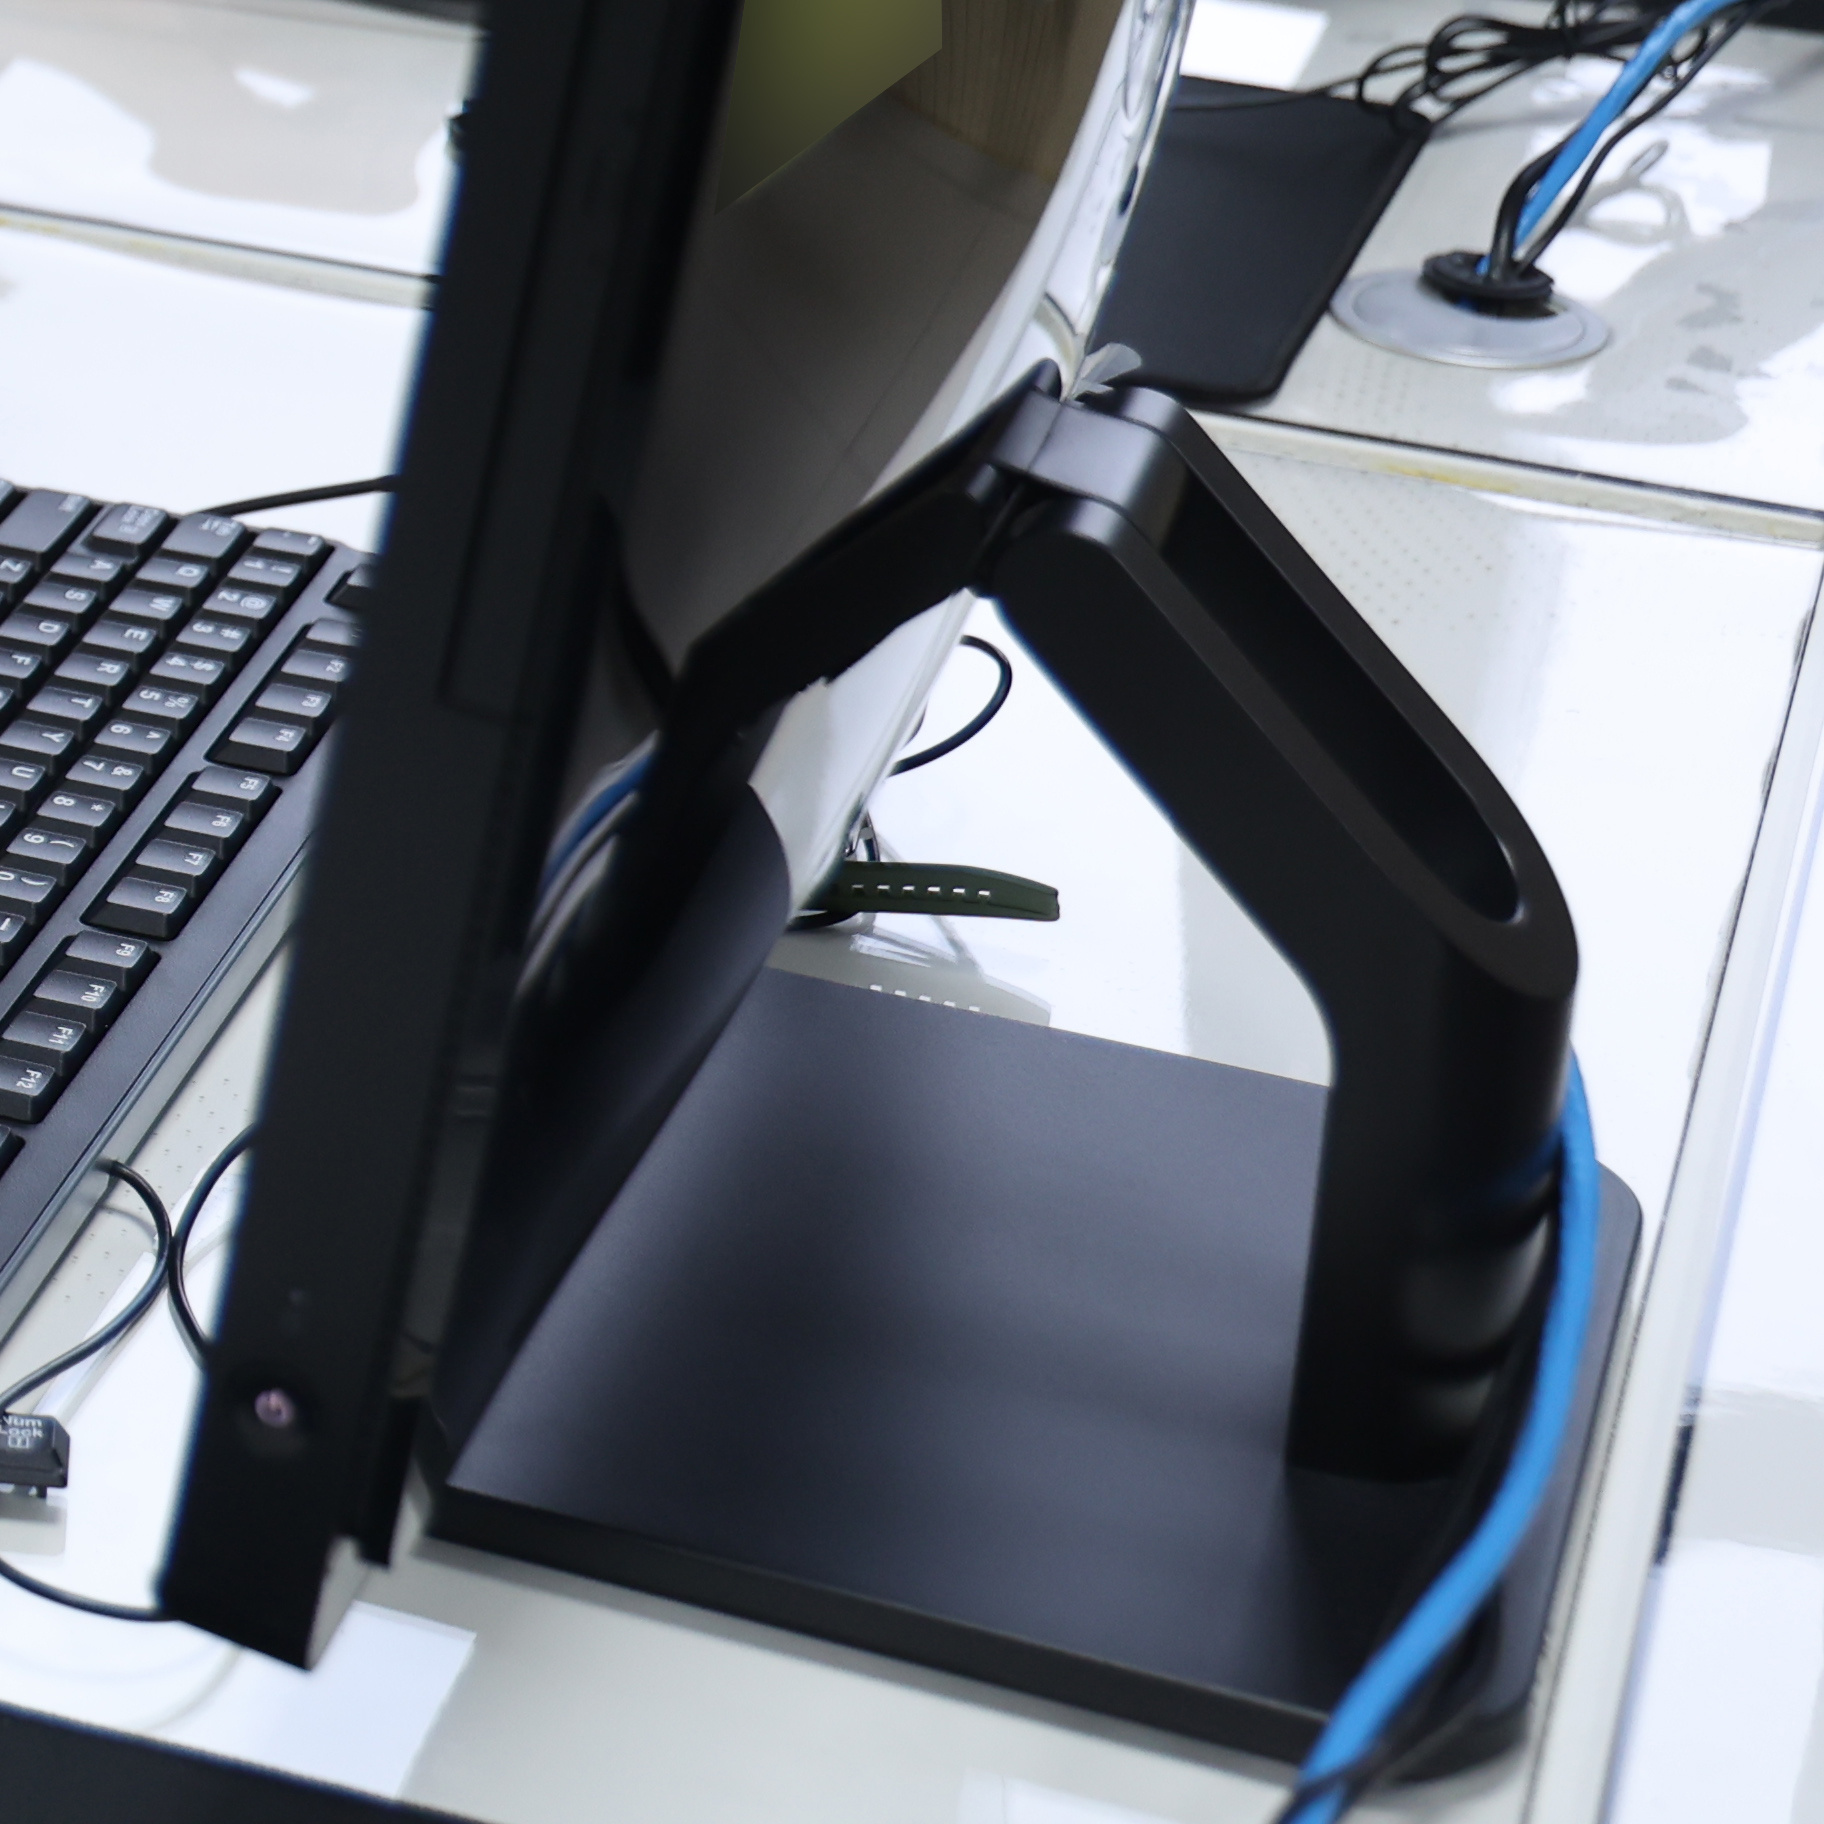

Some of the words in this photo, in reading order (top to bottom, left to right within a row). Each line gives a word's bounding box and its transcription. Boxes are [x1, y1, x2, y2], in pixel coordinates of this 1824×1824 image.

[0, 560, 25, 572] Z
[89, 559, 114, 571] A
[244, 560, 265, 569] 1
[64, 589, 87, 601] S
[218, 590, 241, 602] 2
[149, 597, 175, 611] W
[38, 622, 61, 634] D
[192, 623, 215, 633] 3
[124, 628, 148, 642] E
[11, 654, 31, 666] F
[165, 656, 186, 667] 4
[96, 661, 121, 674] R
[139, 689, 161, 701] 5
[71, 697, 93, 708] T
[110, 724, 132, 735] 6
[274, 729, 296, 742] F4
[41, 731, 65, 743] Y
[82, 759, 105, 771] 7
[11, 766, 36, 778] U
[239, 777, 259, 790] F5
[53, 795, 75, 807] 8
[211, 814, 231, 828] F6
[23, 832, 45, 844] 9
[184, 851, 203, 866] F7
[154, 889, 175, 903] F8
[115, 942, 136, 957] F9
[80, 983, 106, 1003] F10
[48, 1026, 74, 1045] F11
[16, 1068, 42, 1090] F12
